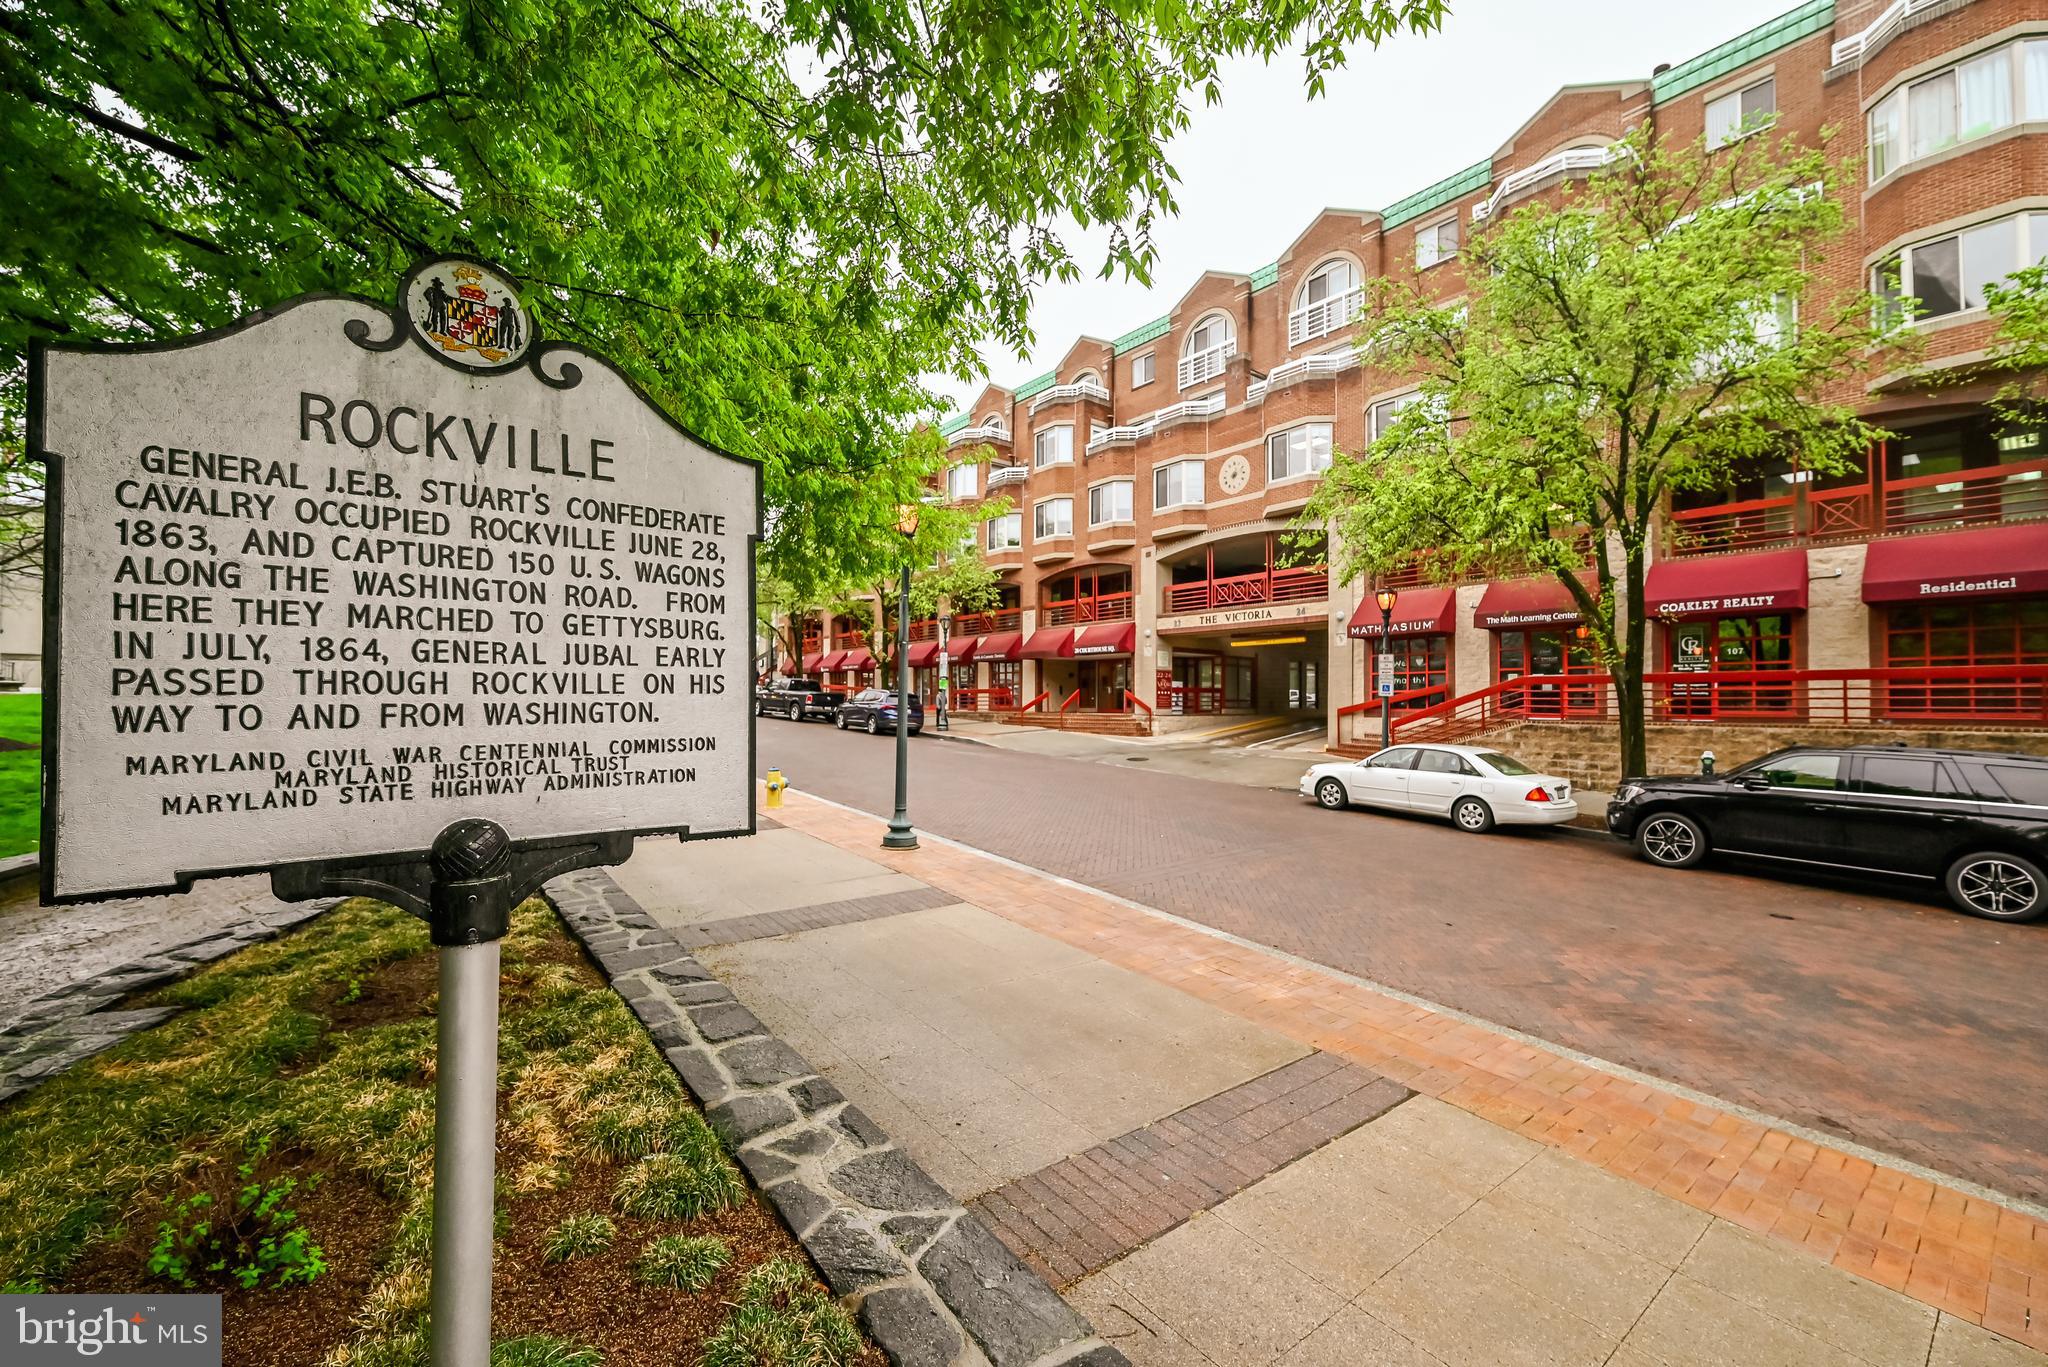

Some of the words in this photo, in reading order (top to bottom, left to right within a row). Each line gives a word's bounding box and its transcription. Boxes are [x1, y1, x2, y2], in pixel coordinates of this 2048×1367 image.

[299, 391, 616, 483] ROCKVILLE
[139, 444, 309, 491] GENERAL
[325, 466, 402, 500] J.E.B.
[420, 478, 551, 516] STUART'S
[566, 496, 726, 536] CONFEDERATE
[114, 479, 276, 521] CAVALRY
[294, 497, 450, 537] OCCUPIED
[470, 515, 616, 552] ROCKVILLE
[628, 532, 683, 558] JUNE
[691, 540, 726, 565] 28,
[114, 518, 218, 556] 1863,
[240, 527, 315, 559] AND
[331, 534, 494, 572] CAPTURED
[507, 550, 555, 576] 150
[634, 560, 725, 589] WAGONS
[113, 555, 242, 589] ALONG
[262, 563, 330, 594] THE
[352, 570, 547, 605] WASHINGTON
[564, 583, 638, 610] ROAD.
[666, 591, 725, 615] FROM
[1659, 600, 1719, 613] COAKLEY
[1723, 595, 1775, 608] REALTY
[1919, 577, 2017, 595] Residential
[112, 591, 213, 624] HERE
[231, 597, 325, 628] THEY
[347, 602, 494, 633] MARCHED
[509, 610, 544, 635] TO
[562, 613, 725, 641] GETTYSBURG.
[1199, 615, 1218, 625] THE
[1225, 610, 1273, 622] VICTORIA
[1486, 617, 1500, 625] The
[1500, 615, 1519, 624] Math
[1520, 613, 1552, 622] Learning
[1552, 612, 1578, 620] Center
[113, 630, 154, 660] IN
[182, 631, 272, 665] JULY,
[299, 636, 389, 666] 1864,
[411, 638, 547, 665] GENERAL
[562, 642, 639, 667] JUBAL
[655, 645, 726, 668] EARLY
[1727, 647, 1744, 655] 107
[111, 667, 265, 697] PASSED
[292, 668, 448, 696] THROUGH
[472, 671, 625, 695] ROCKVILLE
[643, 673, 675, 695] ON
[689, 674, 725, 695] HIS
[111, 704, 195, 734] WAY
[214, 703, 263, 732] TO
[286, 703, 361, 730] AND
[380, 702, 464, 729] FROM
[483, 701, 660, 726] WASHINGTON.
[125, 751, 286, 776] MARYLAND
[306, 748, 373, 769] CIVIL
[392, 746, 443, 765] WAR
[459, 740, 593, 762] CENTENNIAL
[609, 736, 716, 755] COMMISSION
[274, 765, 412, 790] MARYLAND
[432, 758, 562, 781] HISTORICAL
[570, 755, 630, 773] TRUST
[161, 788, 318, 816] MARYLAND
[339, 782, 414, 805] STATE
[431, 776, 527, 799] HIGHWAY
[543, 767, 696, 792] ADMINISTRATION
